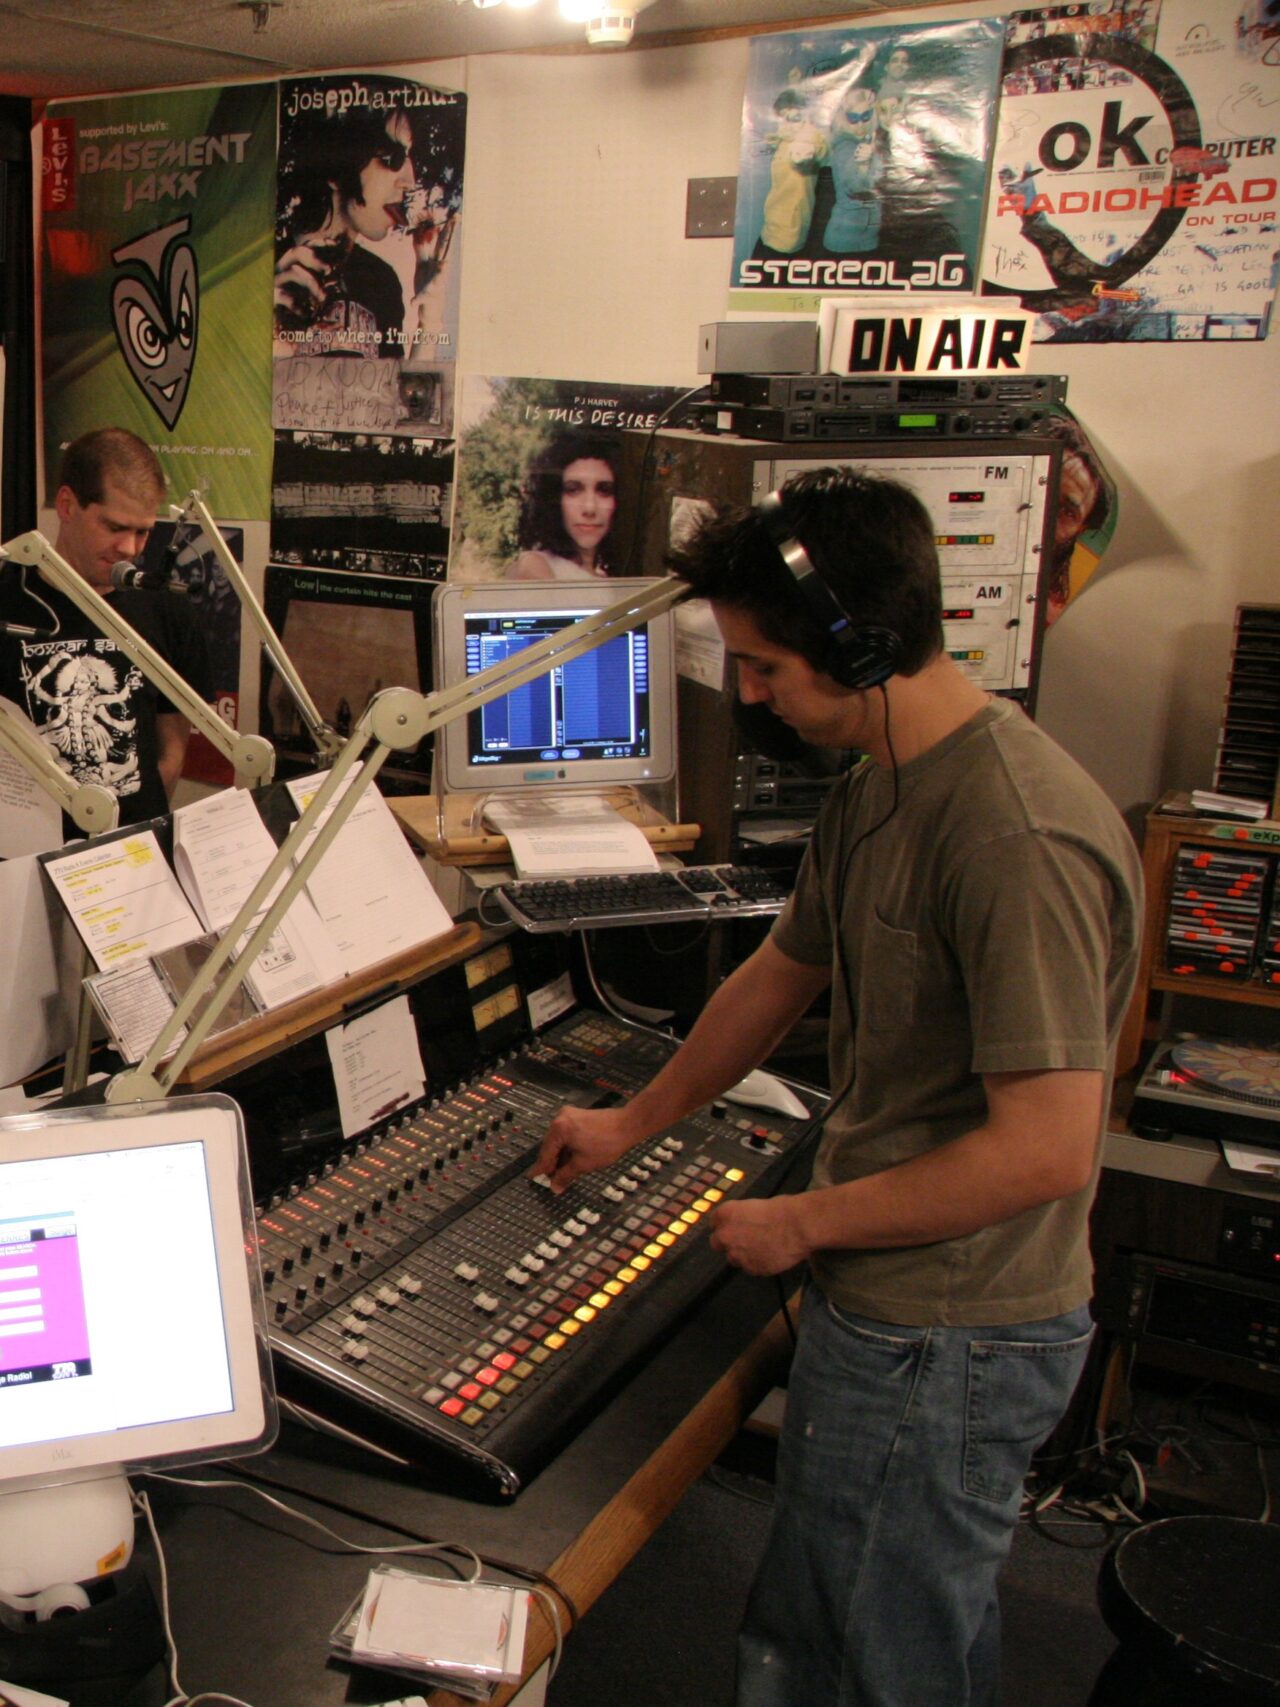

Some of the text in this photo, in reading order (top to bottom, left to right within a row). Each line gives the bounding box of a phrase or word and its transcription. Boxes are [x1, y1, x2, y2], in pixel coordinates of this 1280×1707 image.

[288, 81, 369, 117] joseph
[79, 125, 124, 138] supported
[126, 123, 137, 135] by
[79, 132, 252, 174] BASEMENT
[1155, 136, 1277, 166] CPUTER
[123, 170, 203, 214] JAXX
[996, 178, 1277, 217] RADIOHEAD
[1186, 211, 1276, 227] ON TOUR
[279, 327, 451, 345] come to where i'm from
[848, 317, 1028, 374] ON AIR
[587, 398, 619, 408] HARVEY
[524, 405, 541, 421] IS
[547, 406, 584, 425] THIS
[984, 466, 1009, 480] FM
[976, 586, 1002, 600] AM
[21, 639, 88, 658] boxcar
[7, 1370, 33, 1383] Radio!
